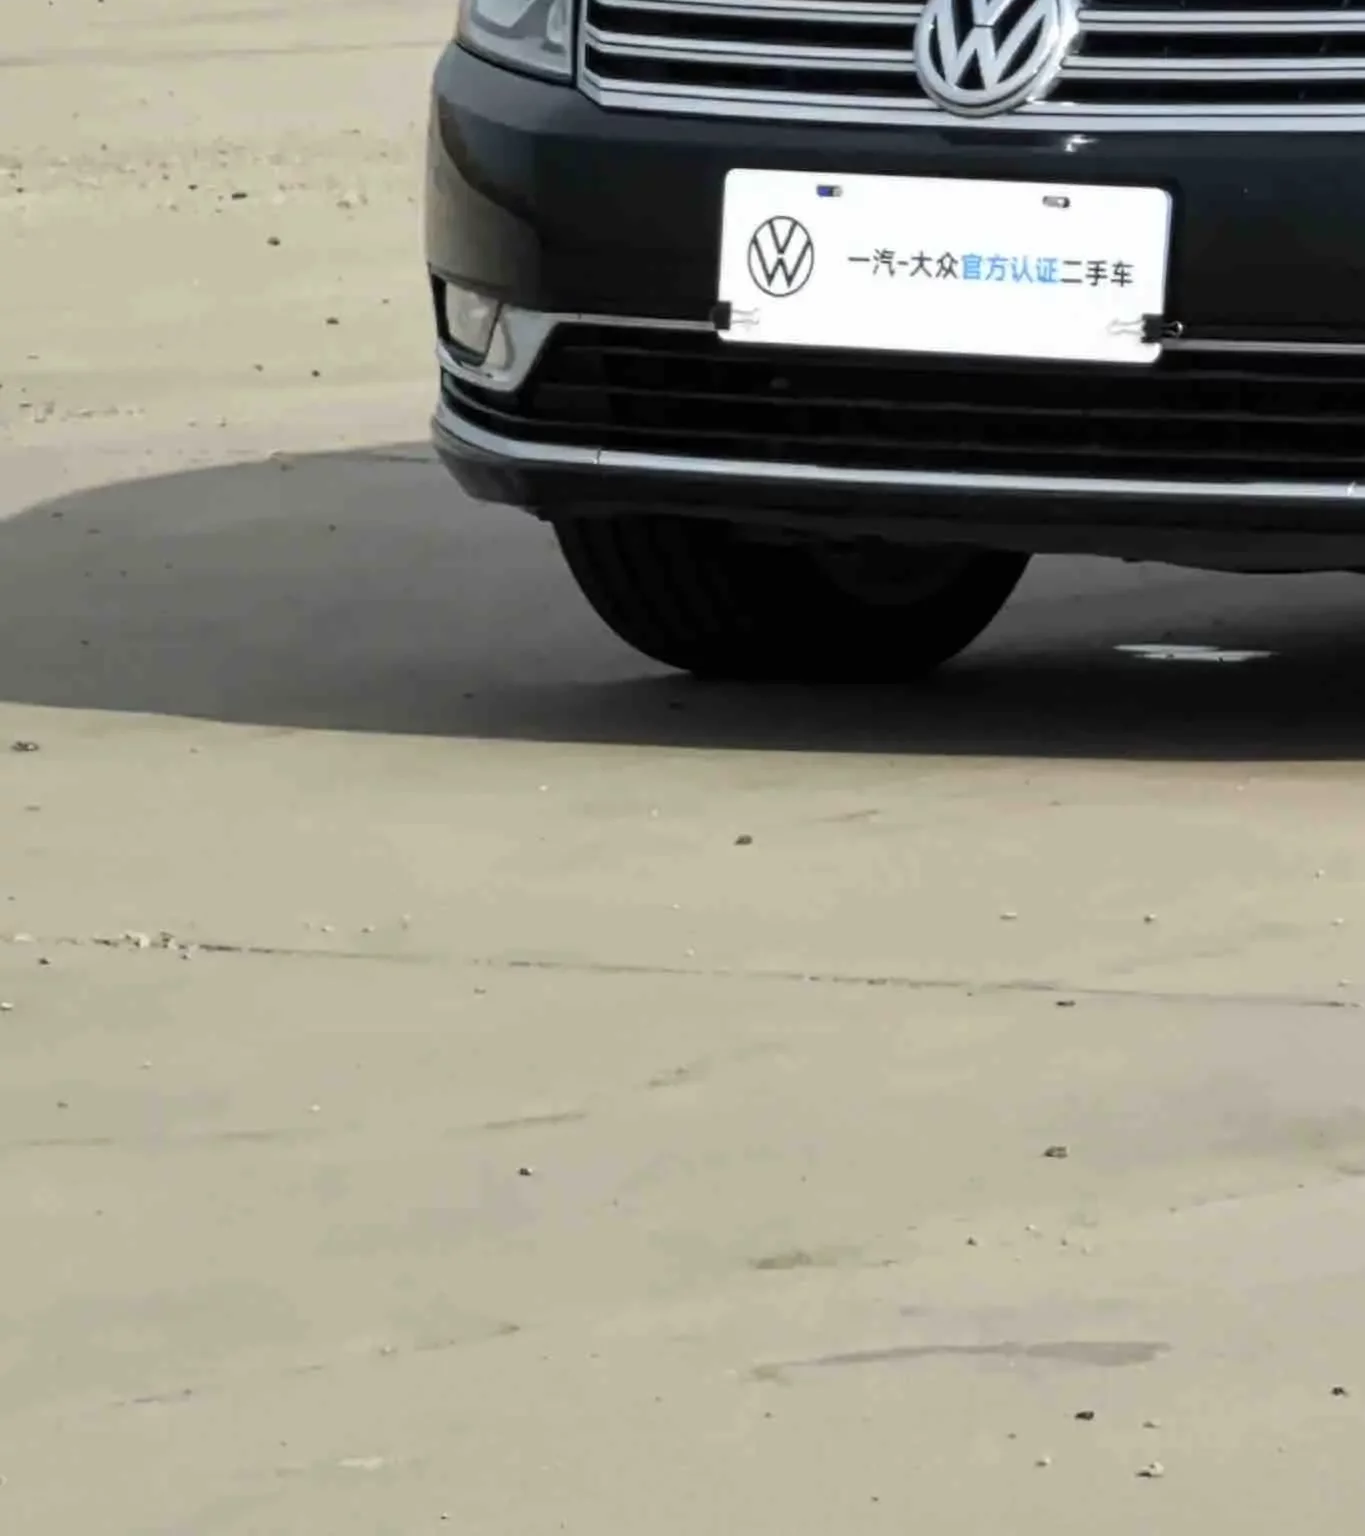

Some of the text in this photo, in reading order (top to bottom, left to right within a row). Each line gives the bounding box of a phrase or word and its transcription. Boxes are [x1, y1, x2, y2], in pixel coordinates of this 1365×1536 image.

[751, 218, 812, 290] VW
[847, 247, 1135, 288] 一汽-大众官方认证二手车
